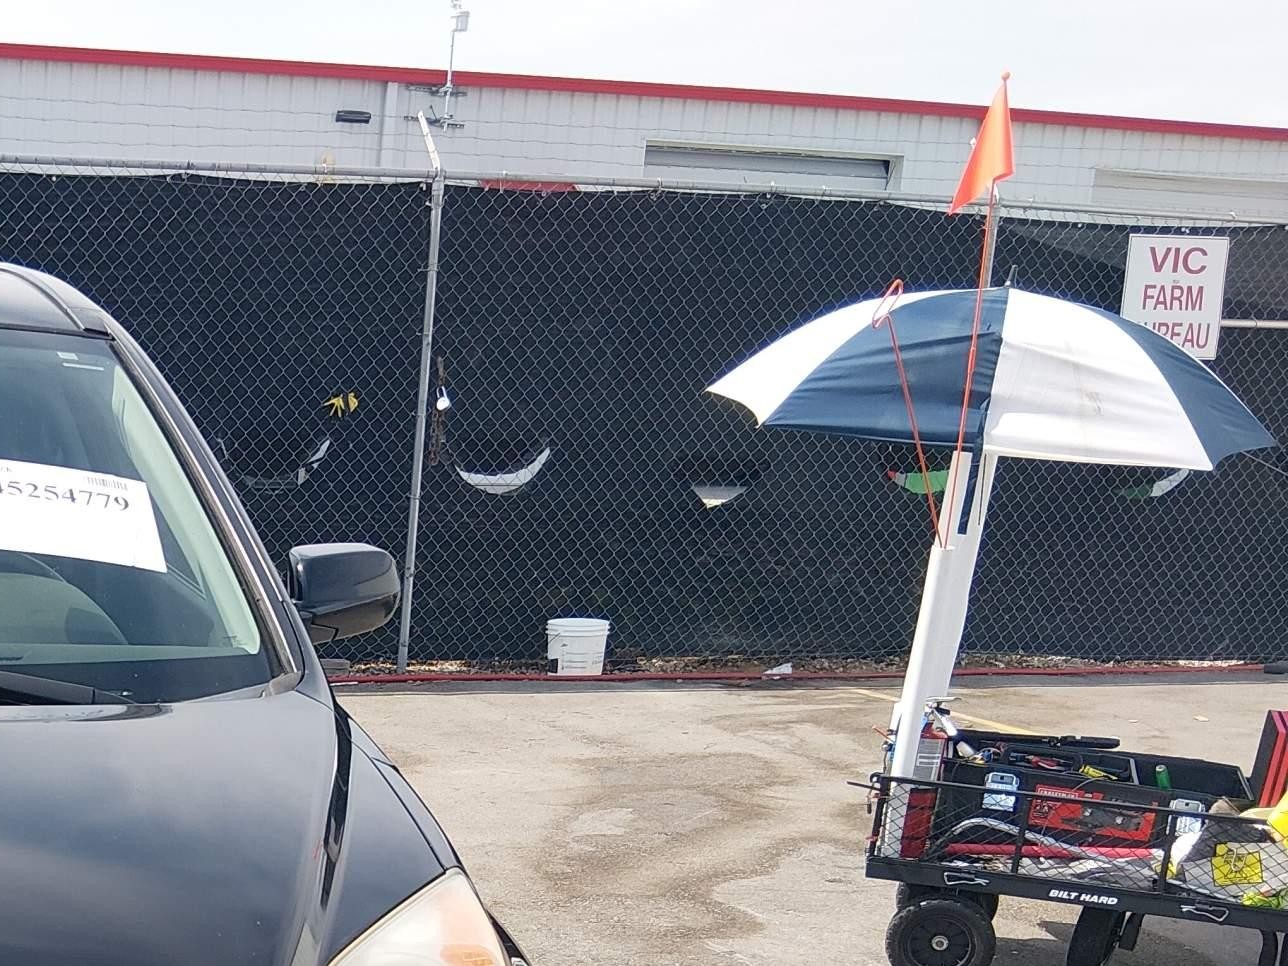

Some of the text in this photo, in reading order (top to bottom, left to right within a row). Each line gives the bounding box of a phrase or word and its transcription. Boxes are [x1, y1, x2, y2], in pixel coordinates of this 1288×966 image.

[1149, 246, 1208, 274] VIC
[1142, 284, 1204, 311] FARM
[1142, 322, 1210, 349] REAU
[1048, 889, 1118, 905] BILT HARD
